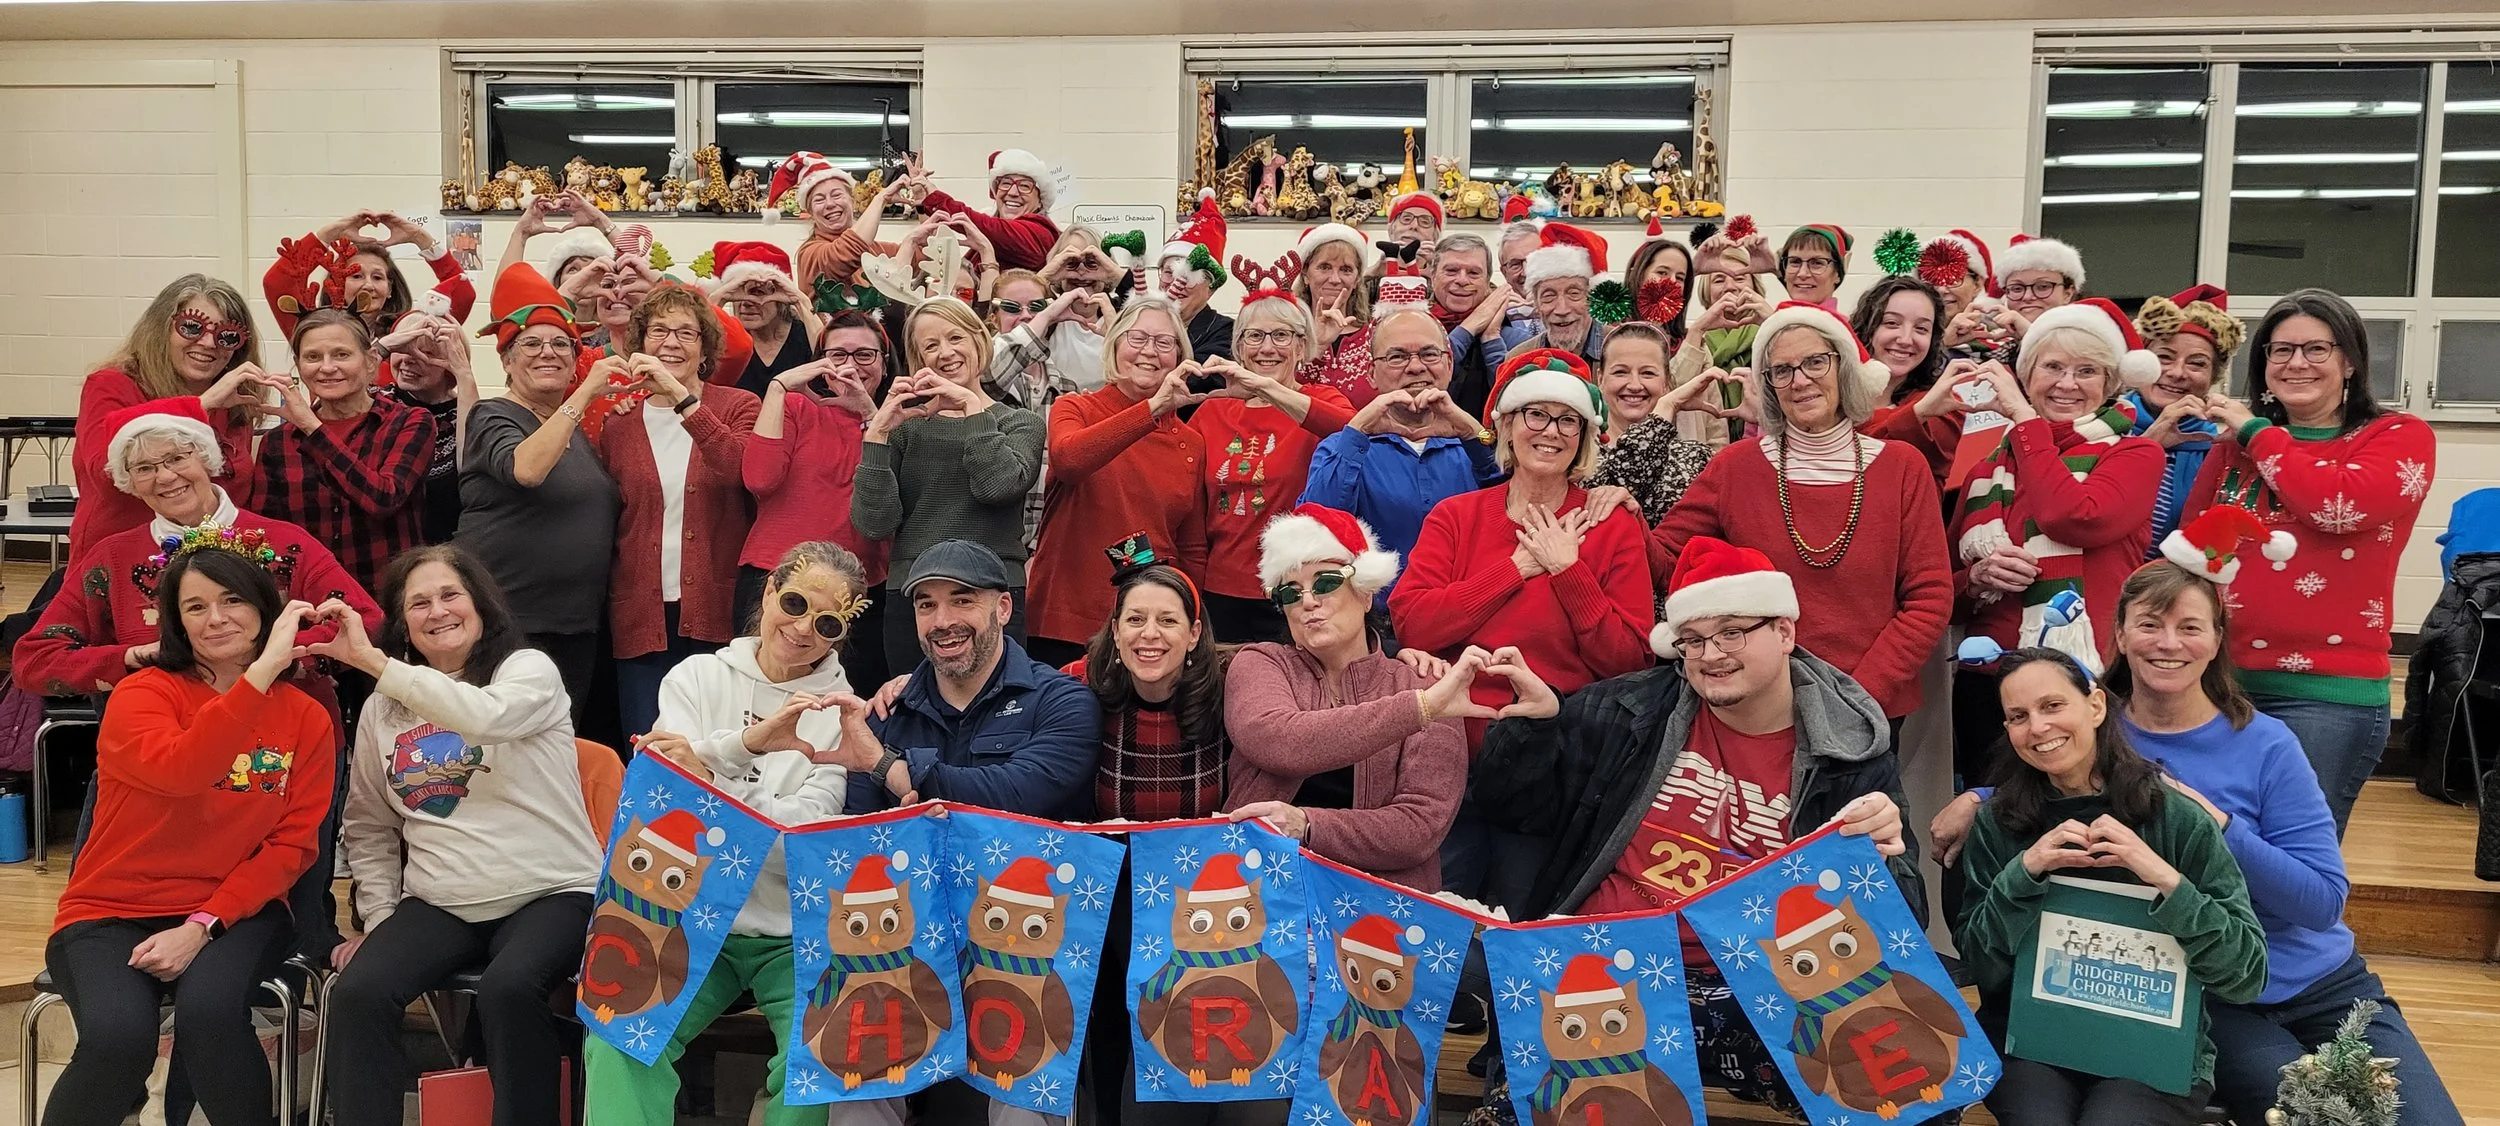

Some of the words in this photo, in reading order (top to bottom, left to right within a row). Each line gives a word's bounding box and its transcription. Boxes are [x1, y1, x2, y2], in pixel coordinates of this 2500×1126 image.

[1641, 840, 1713, 898] 23
[2072, 977, 2149, 1004] CHORALE
[2073, 962, 2173, 994] RIDGEFIELD
[845, 998, 903, 1065] H
[1191, 996, 1257, 1063] R
[1356, 1047, 1402, 1118] A
[1847, 1018, 1930, 1098] E
